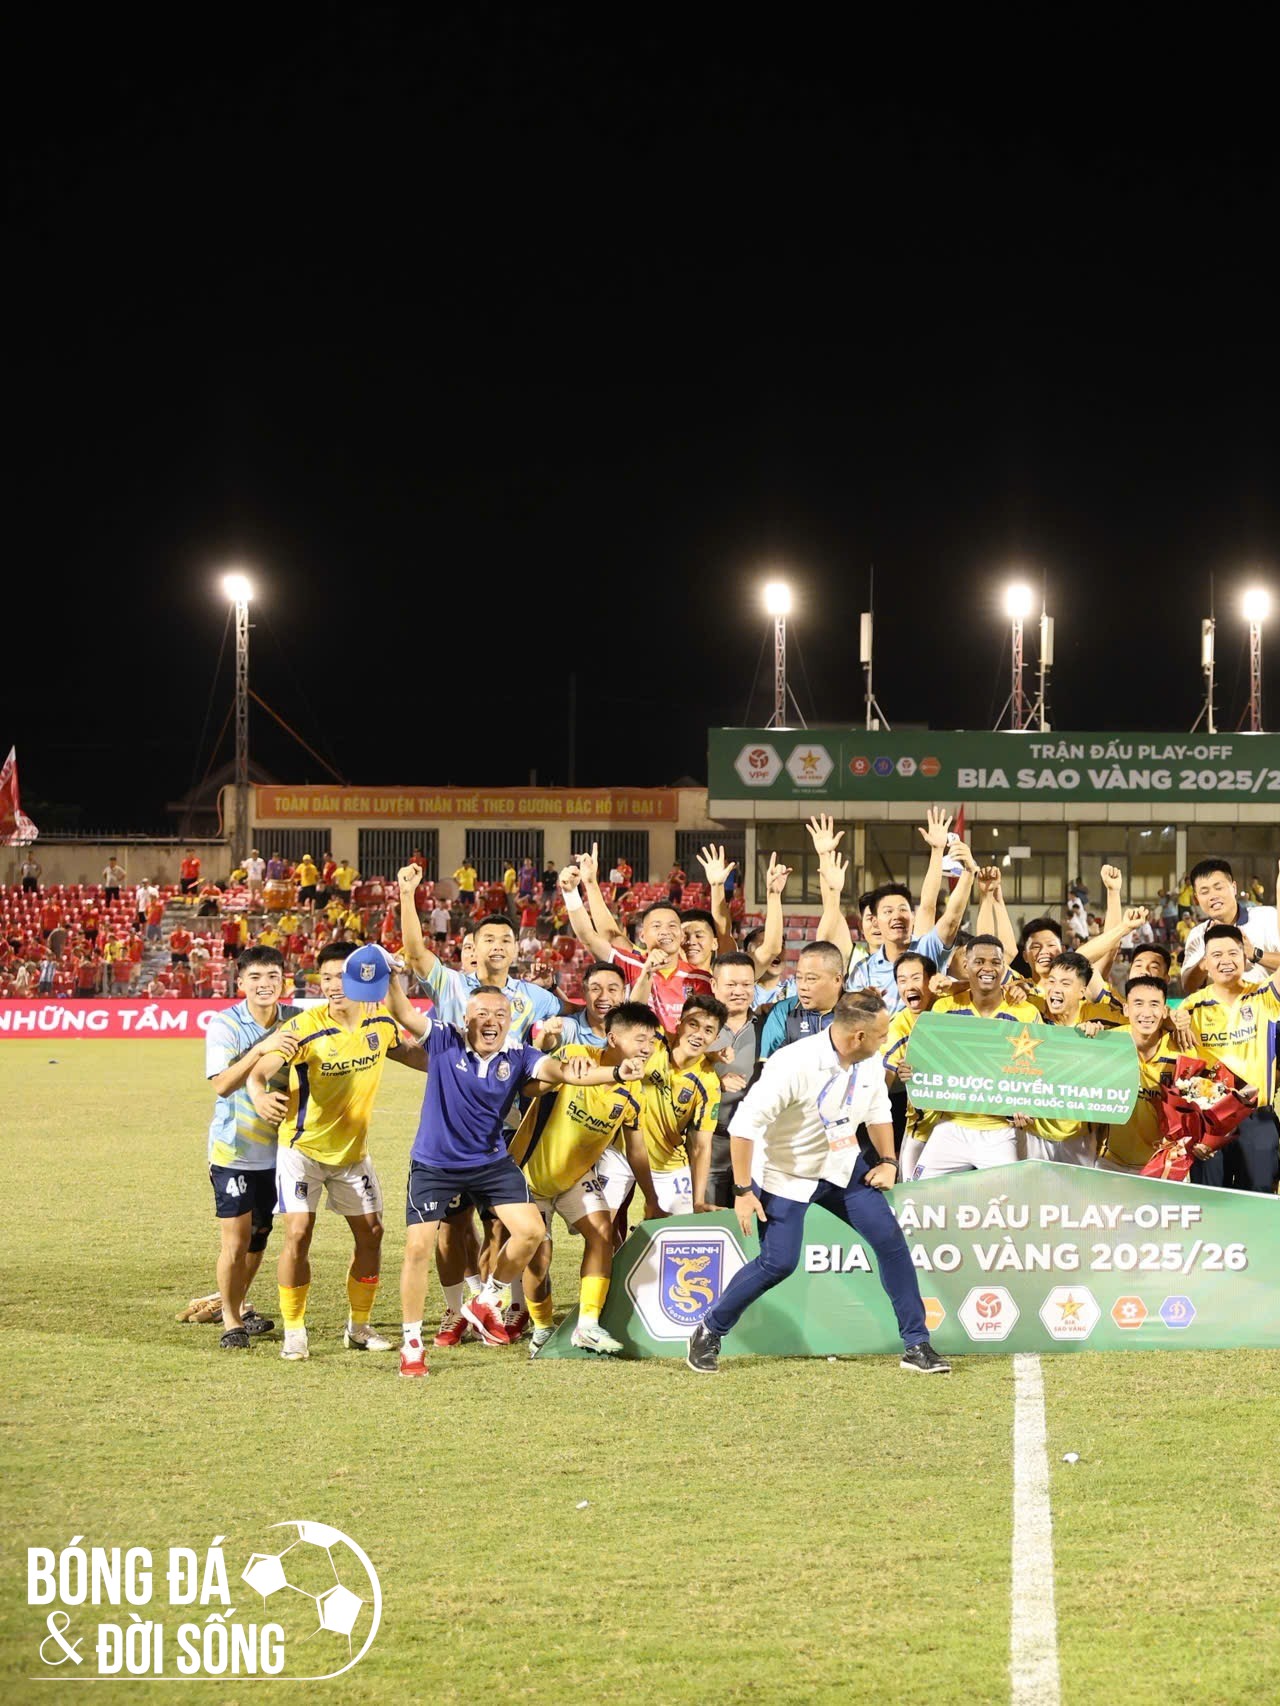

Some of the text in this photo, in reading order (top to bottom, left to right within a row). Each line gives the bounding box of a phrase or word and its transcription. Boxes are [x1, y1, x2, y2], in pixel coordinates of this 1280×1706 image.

[1030, 739, 1233, 762] TRẬN ĐẤU PLAY-OFF
[749, 771, 769, 779] VPF
[957, 768, 1010, 789] BIA
[1016, 768, 1080, 789] SAO
[1087, 763, 1172, 789] VÀNG
[483, 798, 514, 813] THEO
[0, 1005, 110, 1031] NHỮNG
[1200, 1024, 1257, 1041] BAC NINH
[321, 1061, 350, 1071] BAC
[912, 1072, 1131, 1104] CLB ĐƯỢC QUYỀN THAM DỰ
[911, 1087, 933, 1099] GIẢI
[935, 1090, 966, 1101] BÓNG
[969, 1091, 985, 1102] ĐÁ
[1005, 1096, 1031, 1107] ĐỊCH
[1033, 1097, 1065, 1108] QUỐC
[1066, 1101, 1085, 1110] GIA
[1087, 1102, 1130, 1114] 2026/27
[673, 1177, 692, 1194] 12
[893, 1194, 1202, 1235] ẬN ĐẤU PLAY-OFF
[665, 1246, 719, 1254] BAC NINH
[804, 1235, 1249, 1275] BIA AO VÀNG 2025/26
[976, 1322, 1002, 1332] VPF
